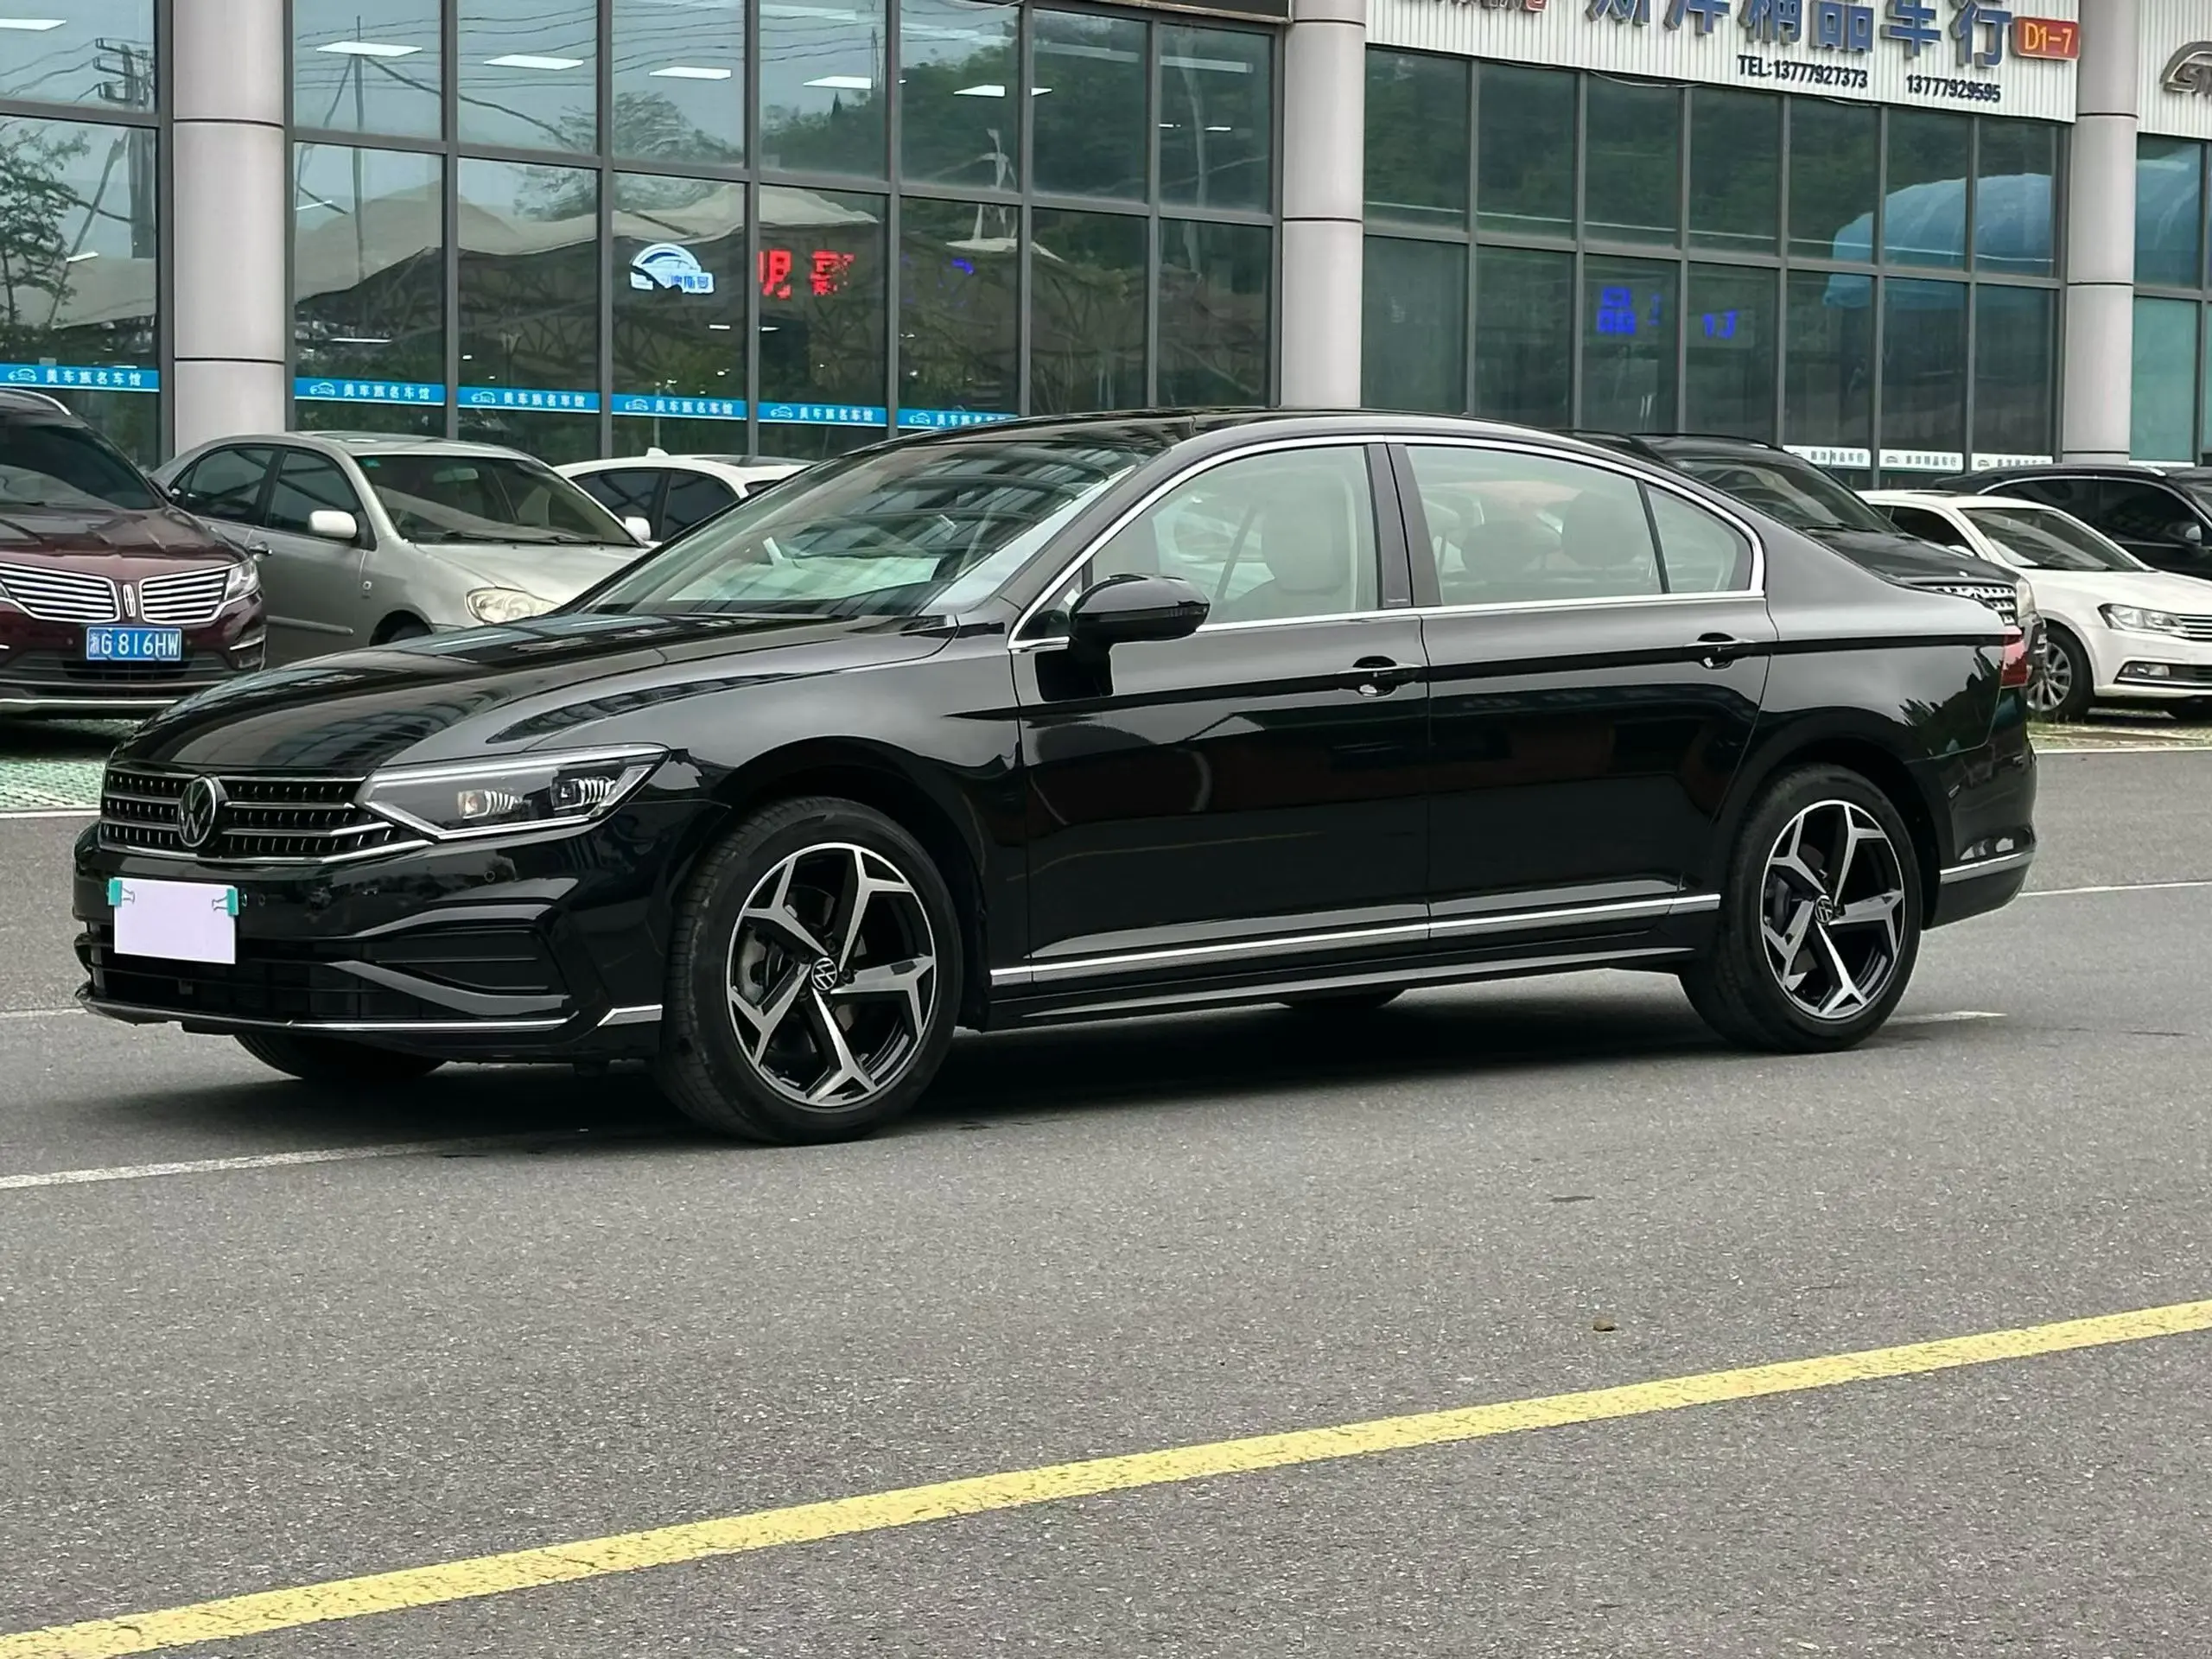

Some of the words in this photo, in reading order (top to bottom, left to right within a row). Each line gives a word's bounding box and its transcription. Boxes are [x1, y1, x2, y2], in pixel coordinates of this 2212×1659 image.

[2024, 22, 2072, 54] D1-7
[1738, 54, 1868, 88] TEL:13777927373
[1907, 74, 2001, 103] 13777929595
